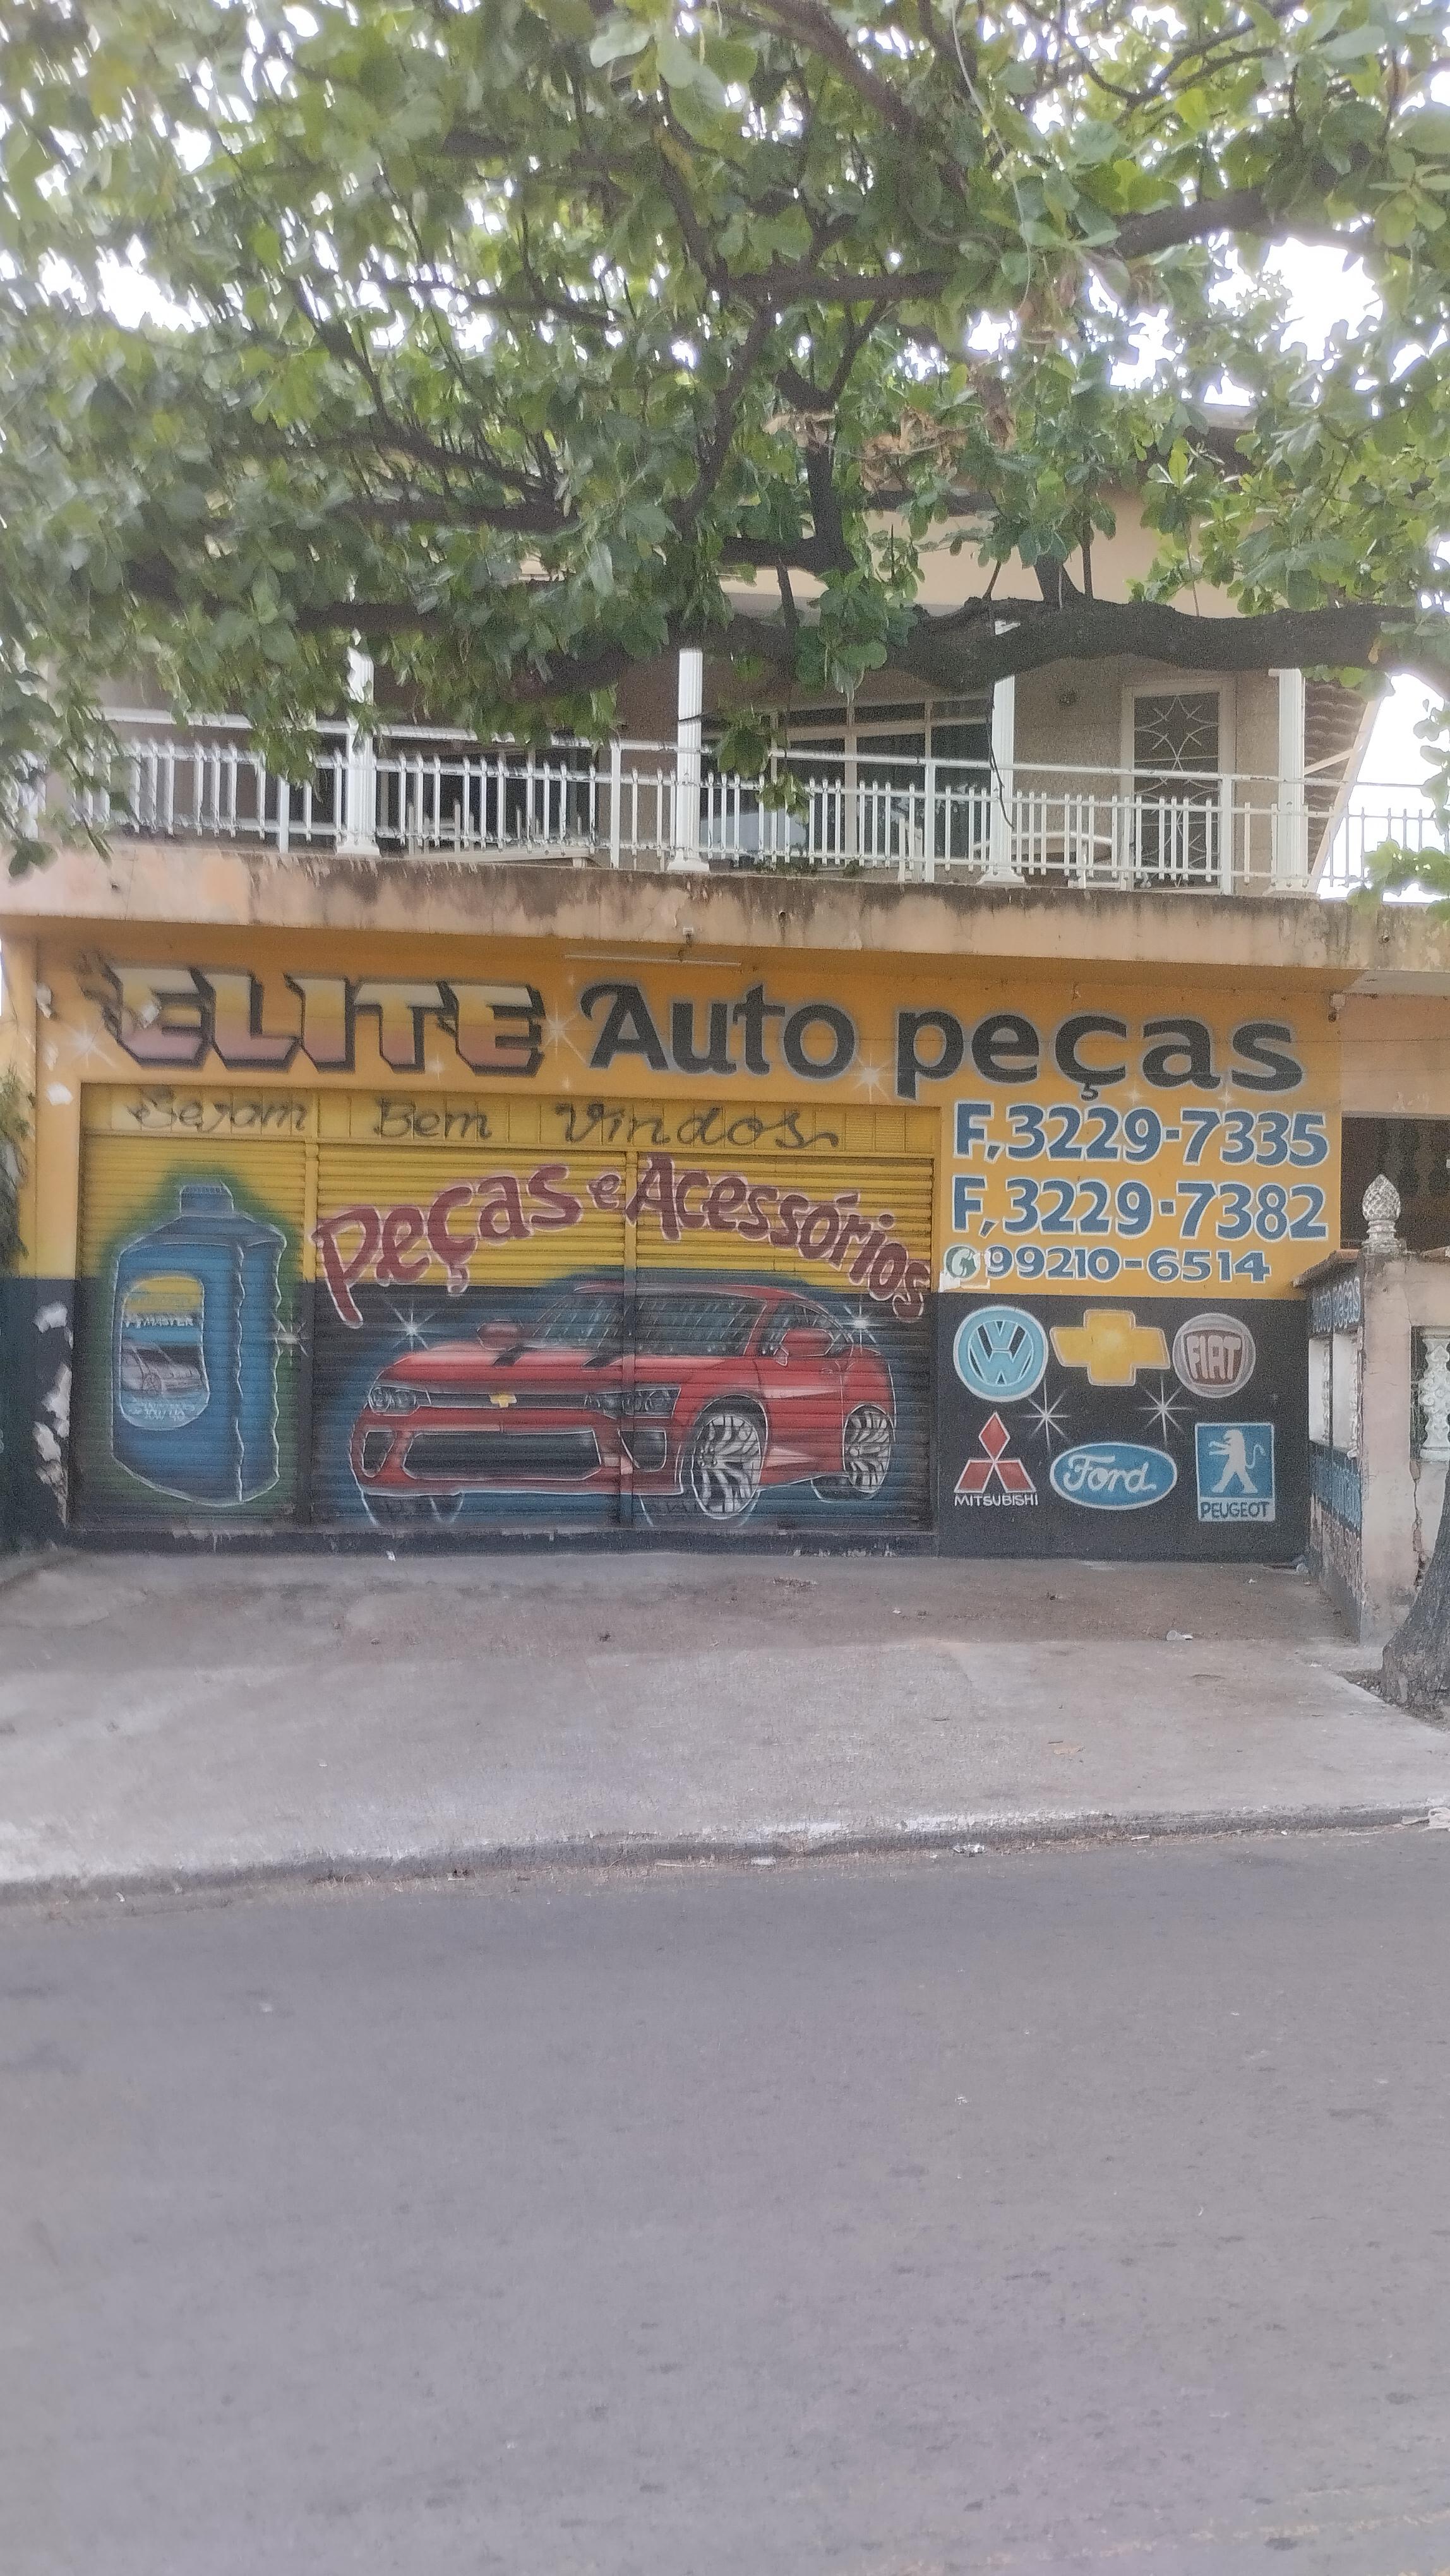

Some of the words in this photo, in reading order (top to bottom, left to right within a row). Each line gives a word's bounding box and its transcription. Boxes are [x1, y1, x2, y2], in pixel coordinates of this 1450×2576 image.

[87, 958, 546, 1076] ELITE
[580, 981, 856, 1080] Auto
[896, 1010, 1303, 1102] peças
[373, 1095, 492, 1139] Bem
[555, 1100, 839, 1148] Vindos
[586, 1172, 621, 1210] e
[625, 1152, 932, 1323] Acessórios
[985, 1245, 1272, 1284] 99210-6514
[1185, 1332, 1243, 1381] FIAT
[1064, 1452, 1158, 1493] Ford
[954, 1492, 1040, 1507] MITSUBISHI
[1201, 1500, 1271, 1518] PEUGEOT
